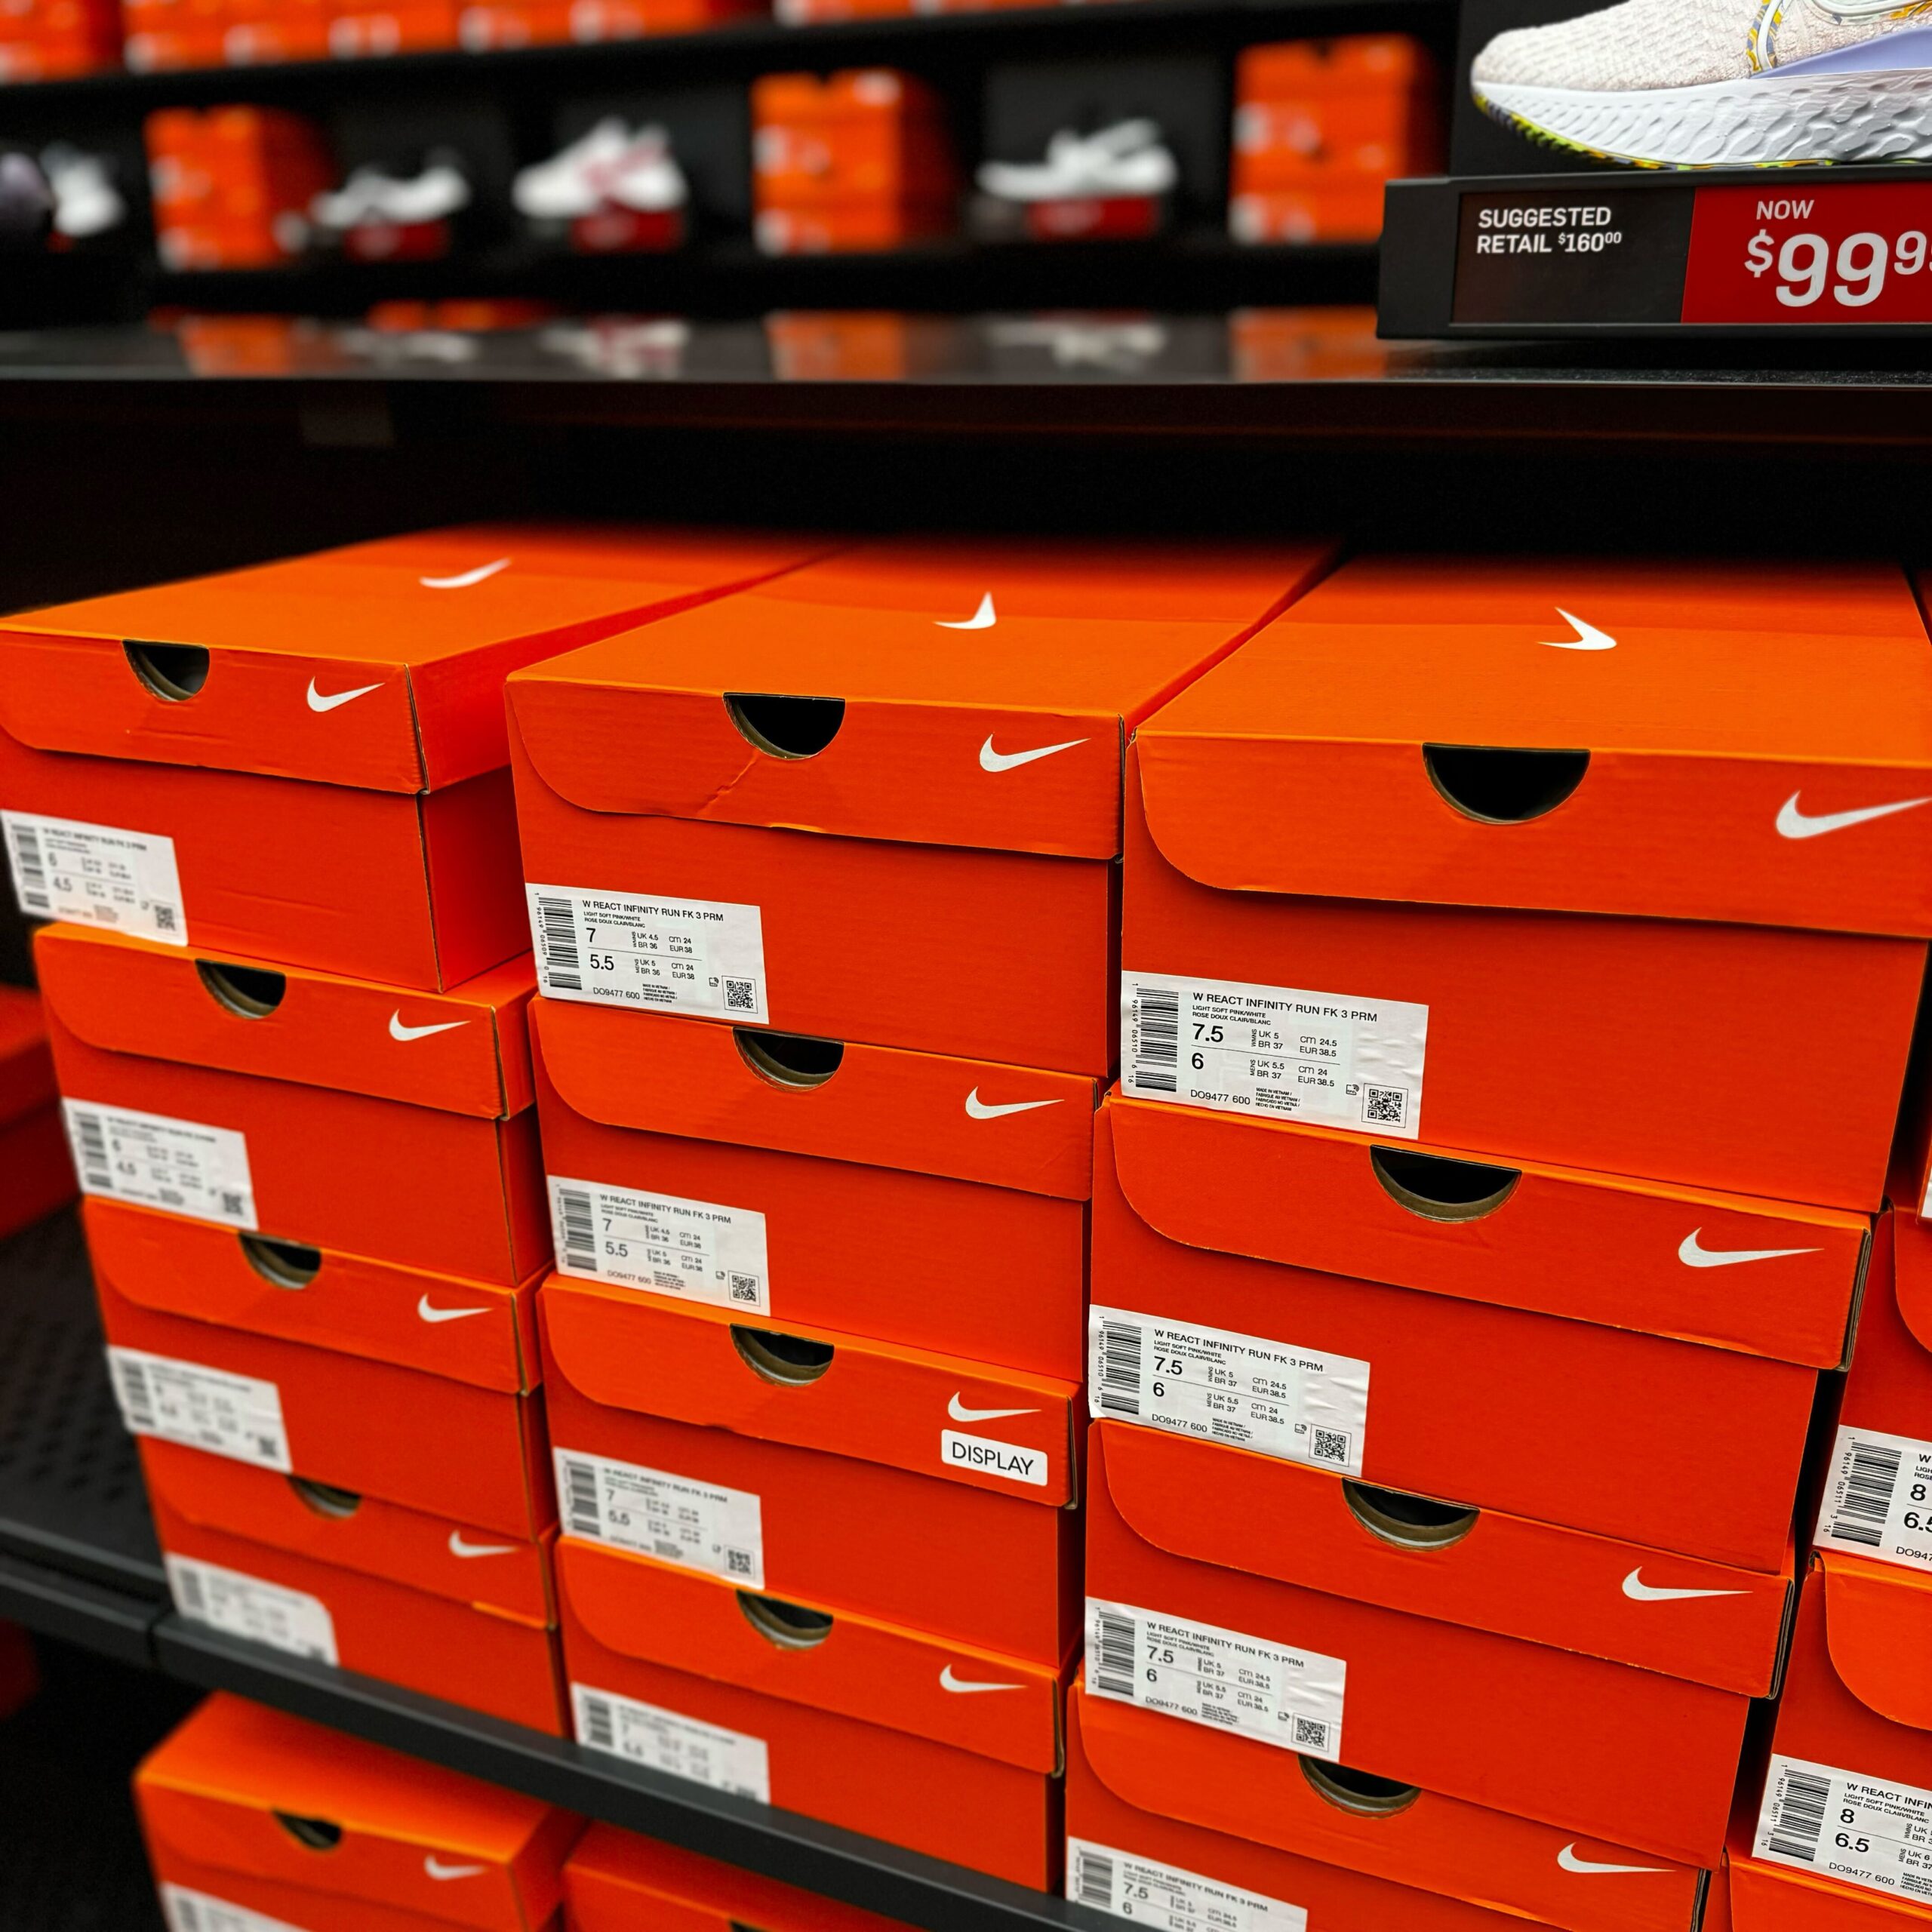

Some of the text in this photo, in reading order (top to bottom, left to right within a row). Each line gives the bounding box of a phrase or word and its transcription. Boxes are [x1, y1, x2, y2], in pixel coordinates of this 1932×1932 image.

[1478, 208, 1611, 228] SUGGESTED
[1756, 200, 1814, 220] NOW
[1476, 234, 1552, 254] RETAIL
[582, 900, 723, 921] W REACT INFINITY RUN FK 3 PRM
[586, 927, 596, 943] 7
[669, 944, 684, 952] EUR
[589, 953, 614, 971] 5.5
[592, 986, 623, 998] DO9477
[625, 991, 640, 1000] 600
[1192, 992, 1377, 1022] W REACT INFINITY RUN FK 3 PRM
[1229, 1008, 1266, 1019] PINK/WHITE
[1229, 1016, 1271, 1026] CLAIR/BLANC
[1192, 1023, 1224, 1043] 7.5
[1259, 1030, 1271, 1038] UK
[1258, 1040, 1270, 1048] BR
[1319, 1038, 1337, 1047] 24.5
[1300, 1045, 1337, 1057] EUR 38.5
[1191, 1052, 1204, 1070] 6
[1257, 1060, 1284, 1070] UK 5.5
[1257, 1069, 1269, 1078] BR
[1317, 1068, 1327, 1076] 24
[1297, 1075, 1335, 1087] EUR 38.5
[1190, 1089, 1251, 1106] DO9477 600
[609, 1195, 636, 1206] REACT
[638, 1201, 672, 1213] INFINITY
[673, 1207, 691, 1217] RUN
[693, 1211, 704, 1219] FK
[712, 1214, 731, 1224] PRM
[602, 1217, 612, 1232] 7
[605, 1241, 629, 1257] 5.5
[1154, 1329, 1323, 1372] W REACT INFINITY RUN FK 3 PRM
[1154, 1355, 1183, 1376] 7.5
[1214, 1368, 1226, 1377] UK
[1214, 1377, 1226, 1385] BR
[1270, 1380, 1287, 1389] 24.5
[1152, 1382, 1164, 1398] 6
[1252, 1385, 1286, 1398] EUR 38.5
[1152, 1413, 1187, 1428] DO9477
[1190, 1422, 1208, 1432] 600
[952, 1441, 1034, 1475] DISPLAY
[1918, 1454, 1932, 1463] W
[1909, 1483, 1927, 1501] 8
[1147, 1621, 1156, 1629] W
[1158, 1624, 1189, 1638] REACT
[1192, 1632, 1232, 1649] INFINITY
[1235, 1643, 1255, 1655] RUN
[1258, 1649, 1271, 1660] FK
[1281, 1656, 1303, 1668] PRM
[1146, 1644, 1174, 1664] 7.5
[1146, 1668, 1157, 1682] 6
[1847, 1782, 1859, 1791] W
[1861, 1786, 1903, 1802] REACT
[1844, 1792, 1925, 1817] LIGHT SOFT PINK/WHITE
[1840, 1808, 1855, 1824] 8
[1835, 1832, 1870, 1853] 6.5
[1906, 1858, 1920, 1867] BR
[1908, 1850, 1922, 1859] UK
[1829, 1862, 1895, 1886] DO9477 600
[1124, 1881, 1149, 1900] 7.5
[1122, 1902, 1133, 1915] 6
